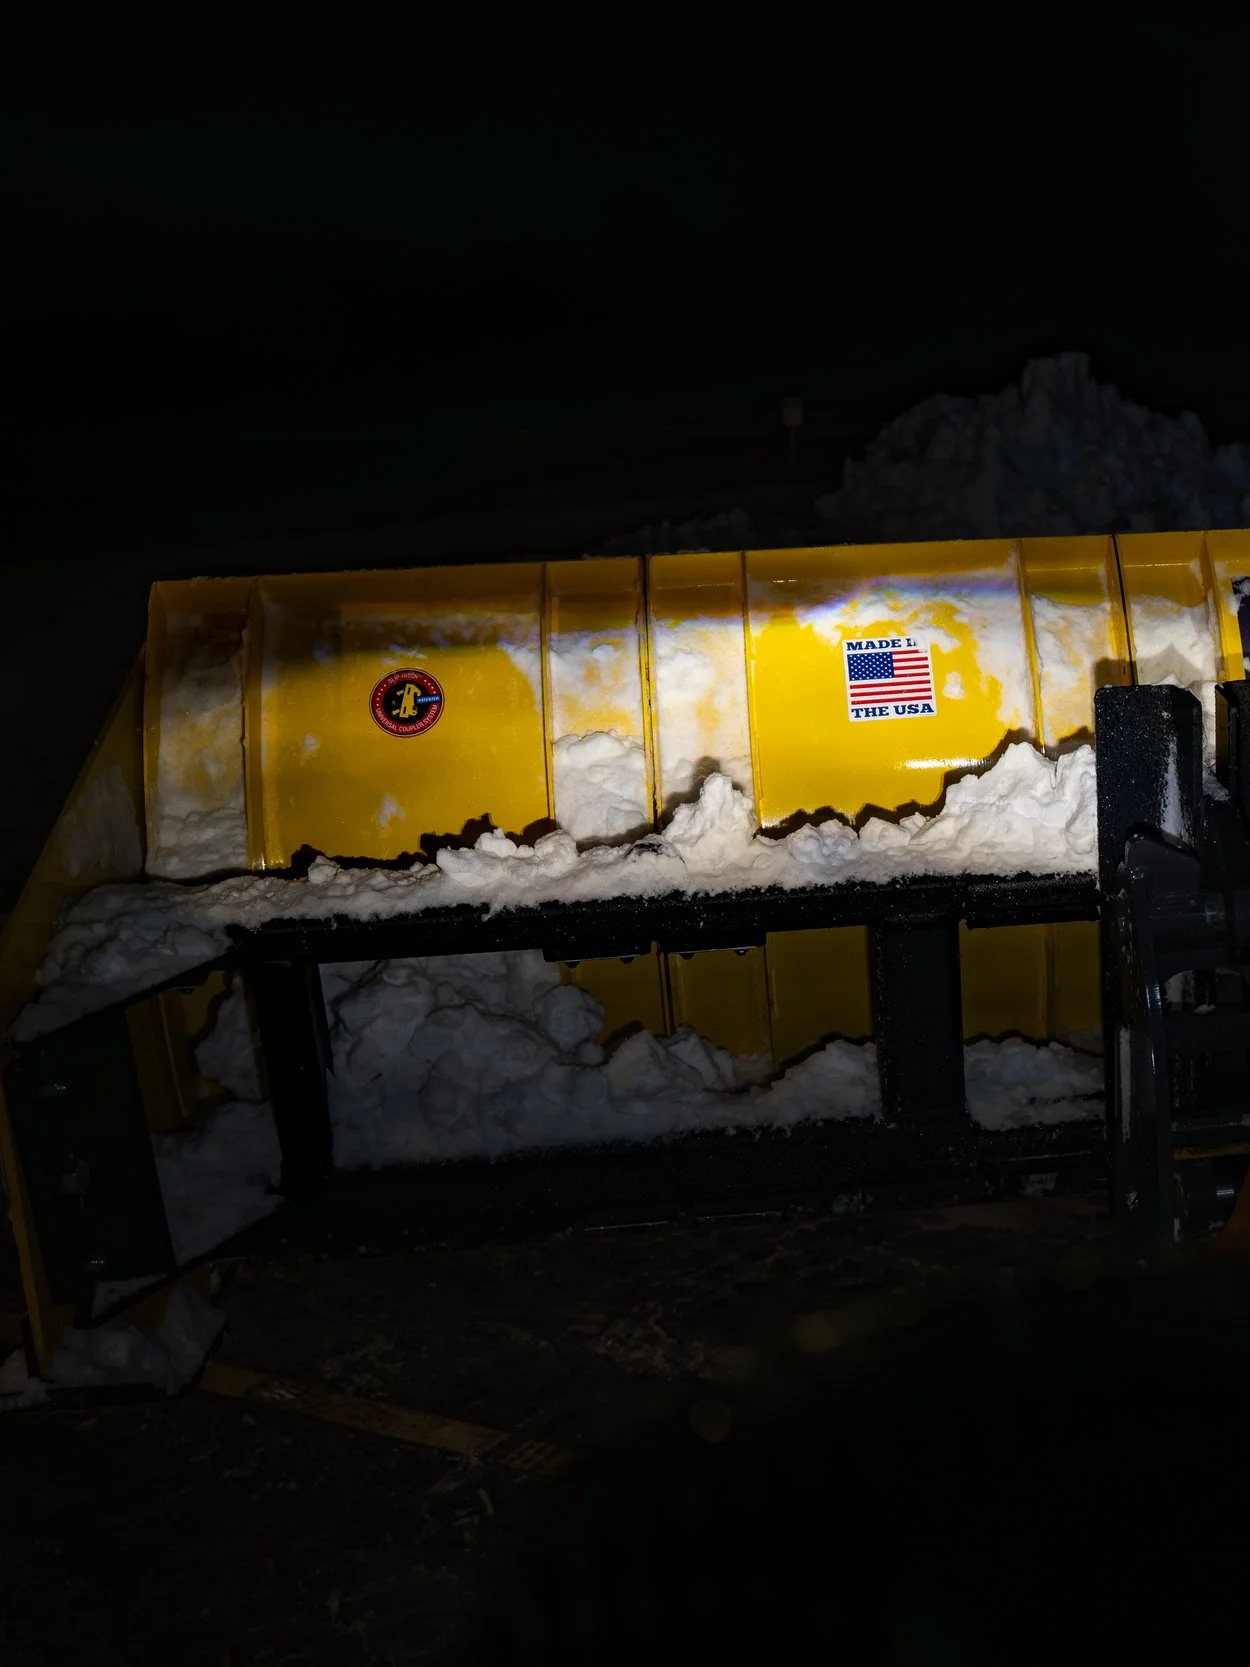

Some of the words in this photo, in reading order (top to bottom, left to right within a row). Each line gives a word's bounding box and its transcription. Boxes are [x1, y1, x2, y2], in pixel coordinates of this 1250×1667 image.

[846, 639, 901, 651] MADE
[851, 706, 889, 718] THE
[893, 703, 934, 715] USA
[376, 708, 397, 731] UNIVERSAL
[398, 722, 424, 732] COUPLER
[424, 705, 438, 724] SYSTEM
